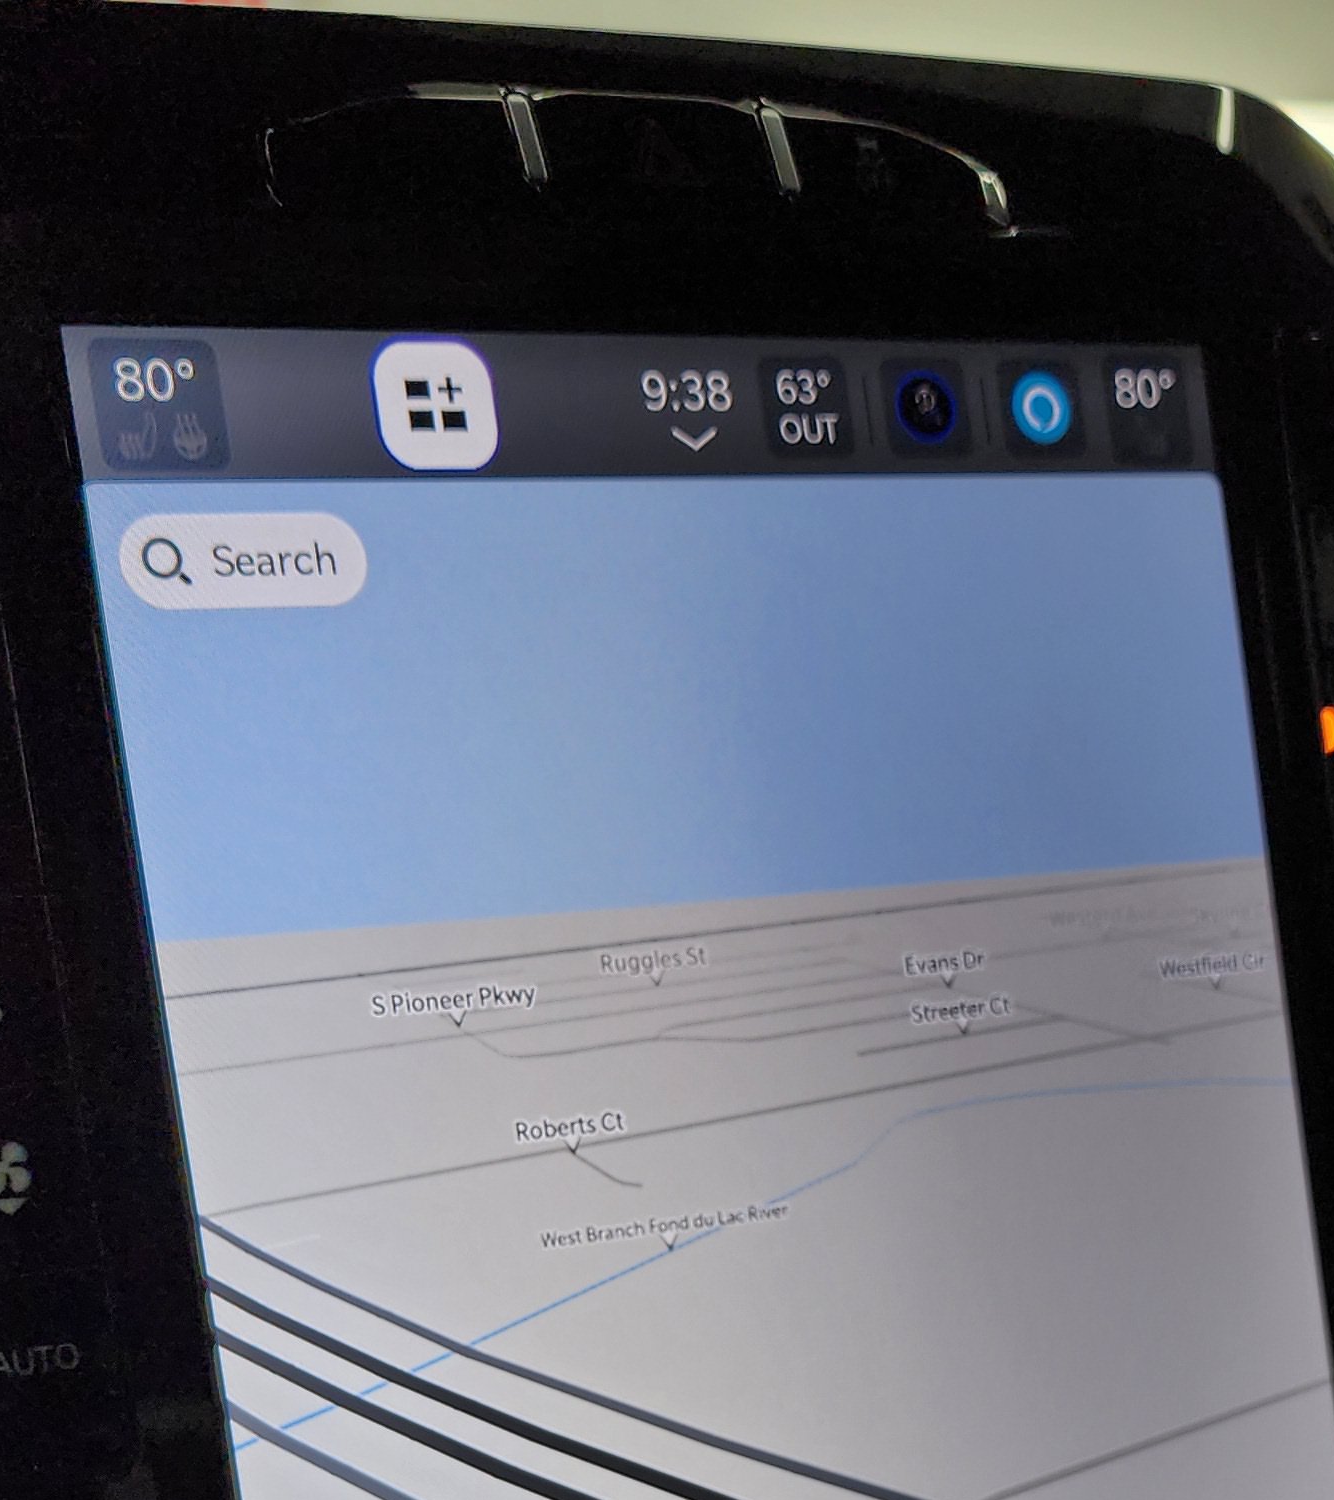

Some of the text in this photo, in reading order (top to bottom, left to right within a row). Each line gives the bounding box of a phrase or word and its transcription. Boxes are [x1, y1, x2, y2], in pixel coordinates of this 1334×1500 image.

[114, 356, 195, 402] 80°
[640, 368, 733, 413] 9:38
[779, 412, 839, 445] OUT
[211, 541, 337, 577] Search
[600, 946, 706, 976] Ruggles St
[904, 951, 985, 976] Evans Dr
[1159, 954, 1238, 976] Westfield
[371, 985, 537, 1016] S Pioneer Pkwy
[910, 996, 1011, 1023] Streeter Ct
[515, 1111, 625, 1142] Roberts Ct
[540, 1204, 790, 1248] West Branch Fond du Lac River
